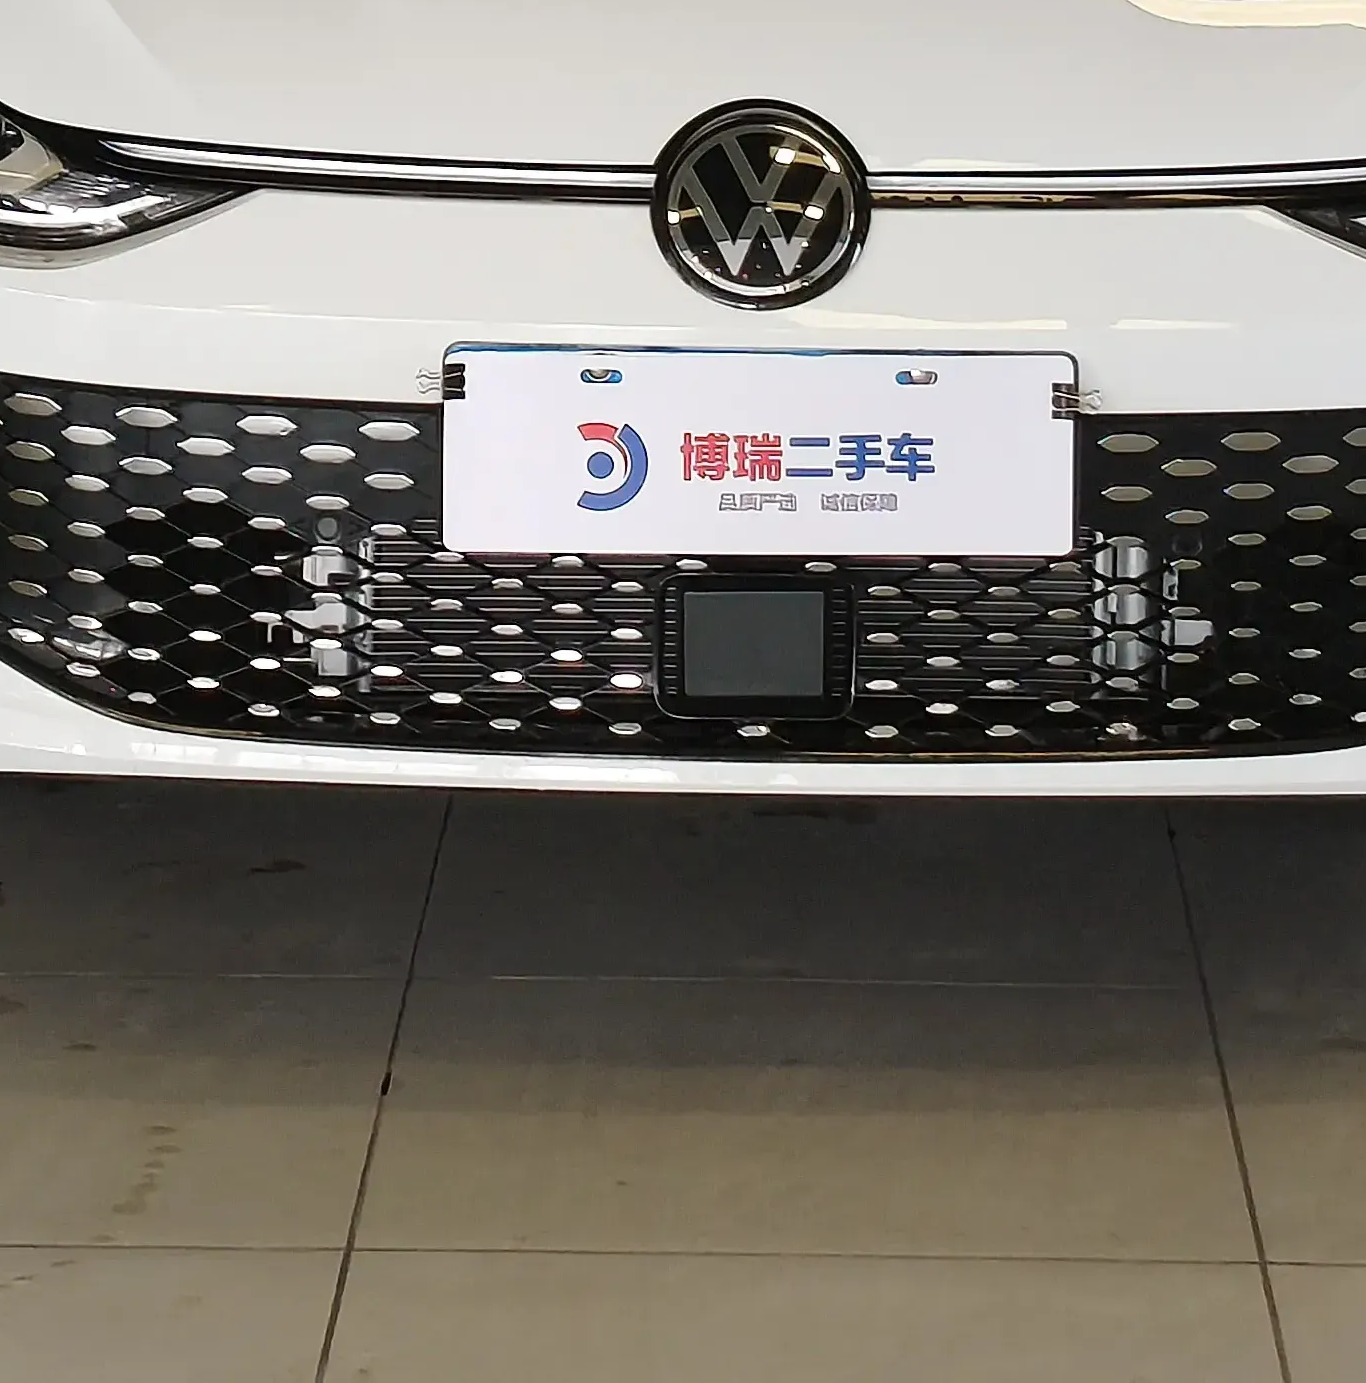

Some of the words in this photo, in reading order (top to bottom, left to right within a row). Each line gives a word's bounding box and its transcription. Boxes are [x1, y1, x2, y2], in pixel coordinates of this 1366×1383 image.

[675, 128, 847, 280] VW
[680, 432, 935, 481] 博瑞二手车
